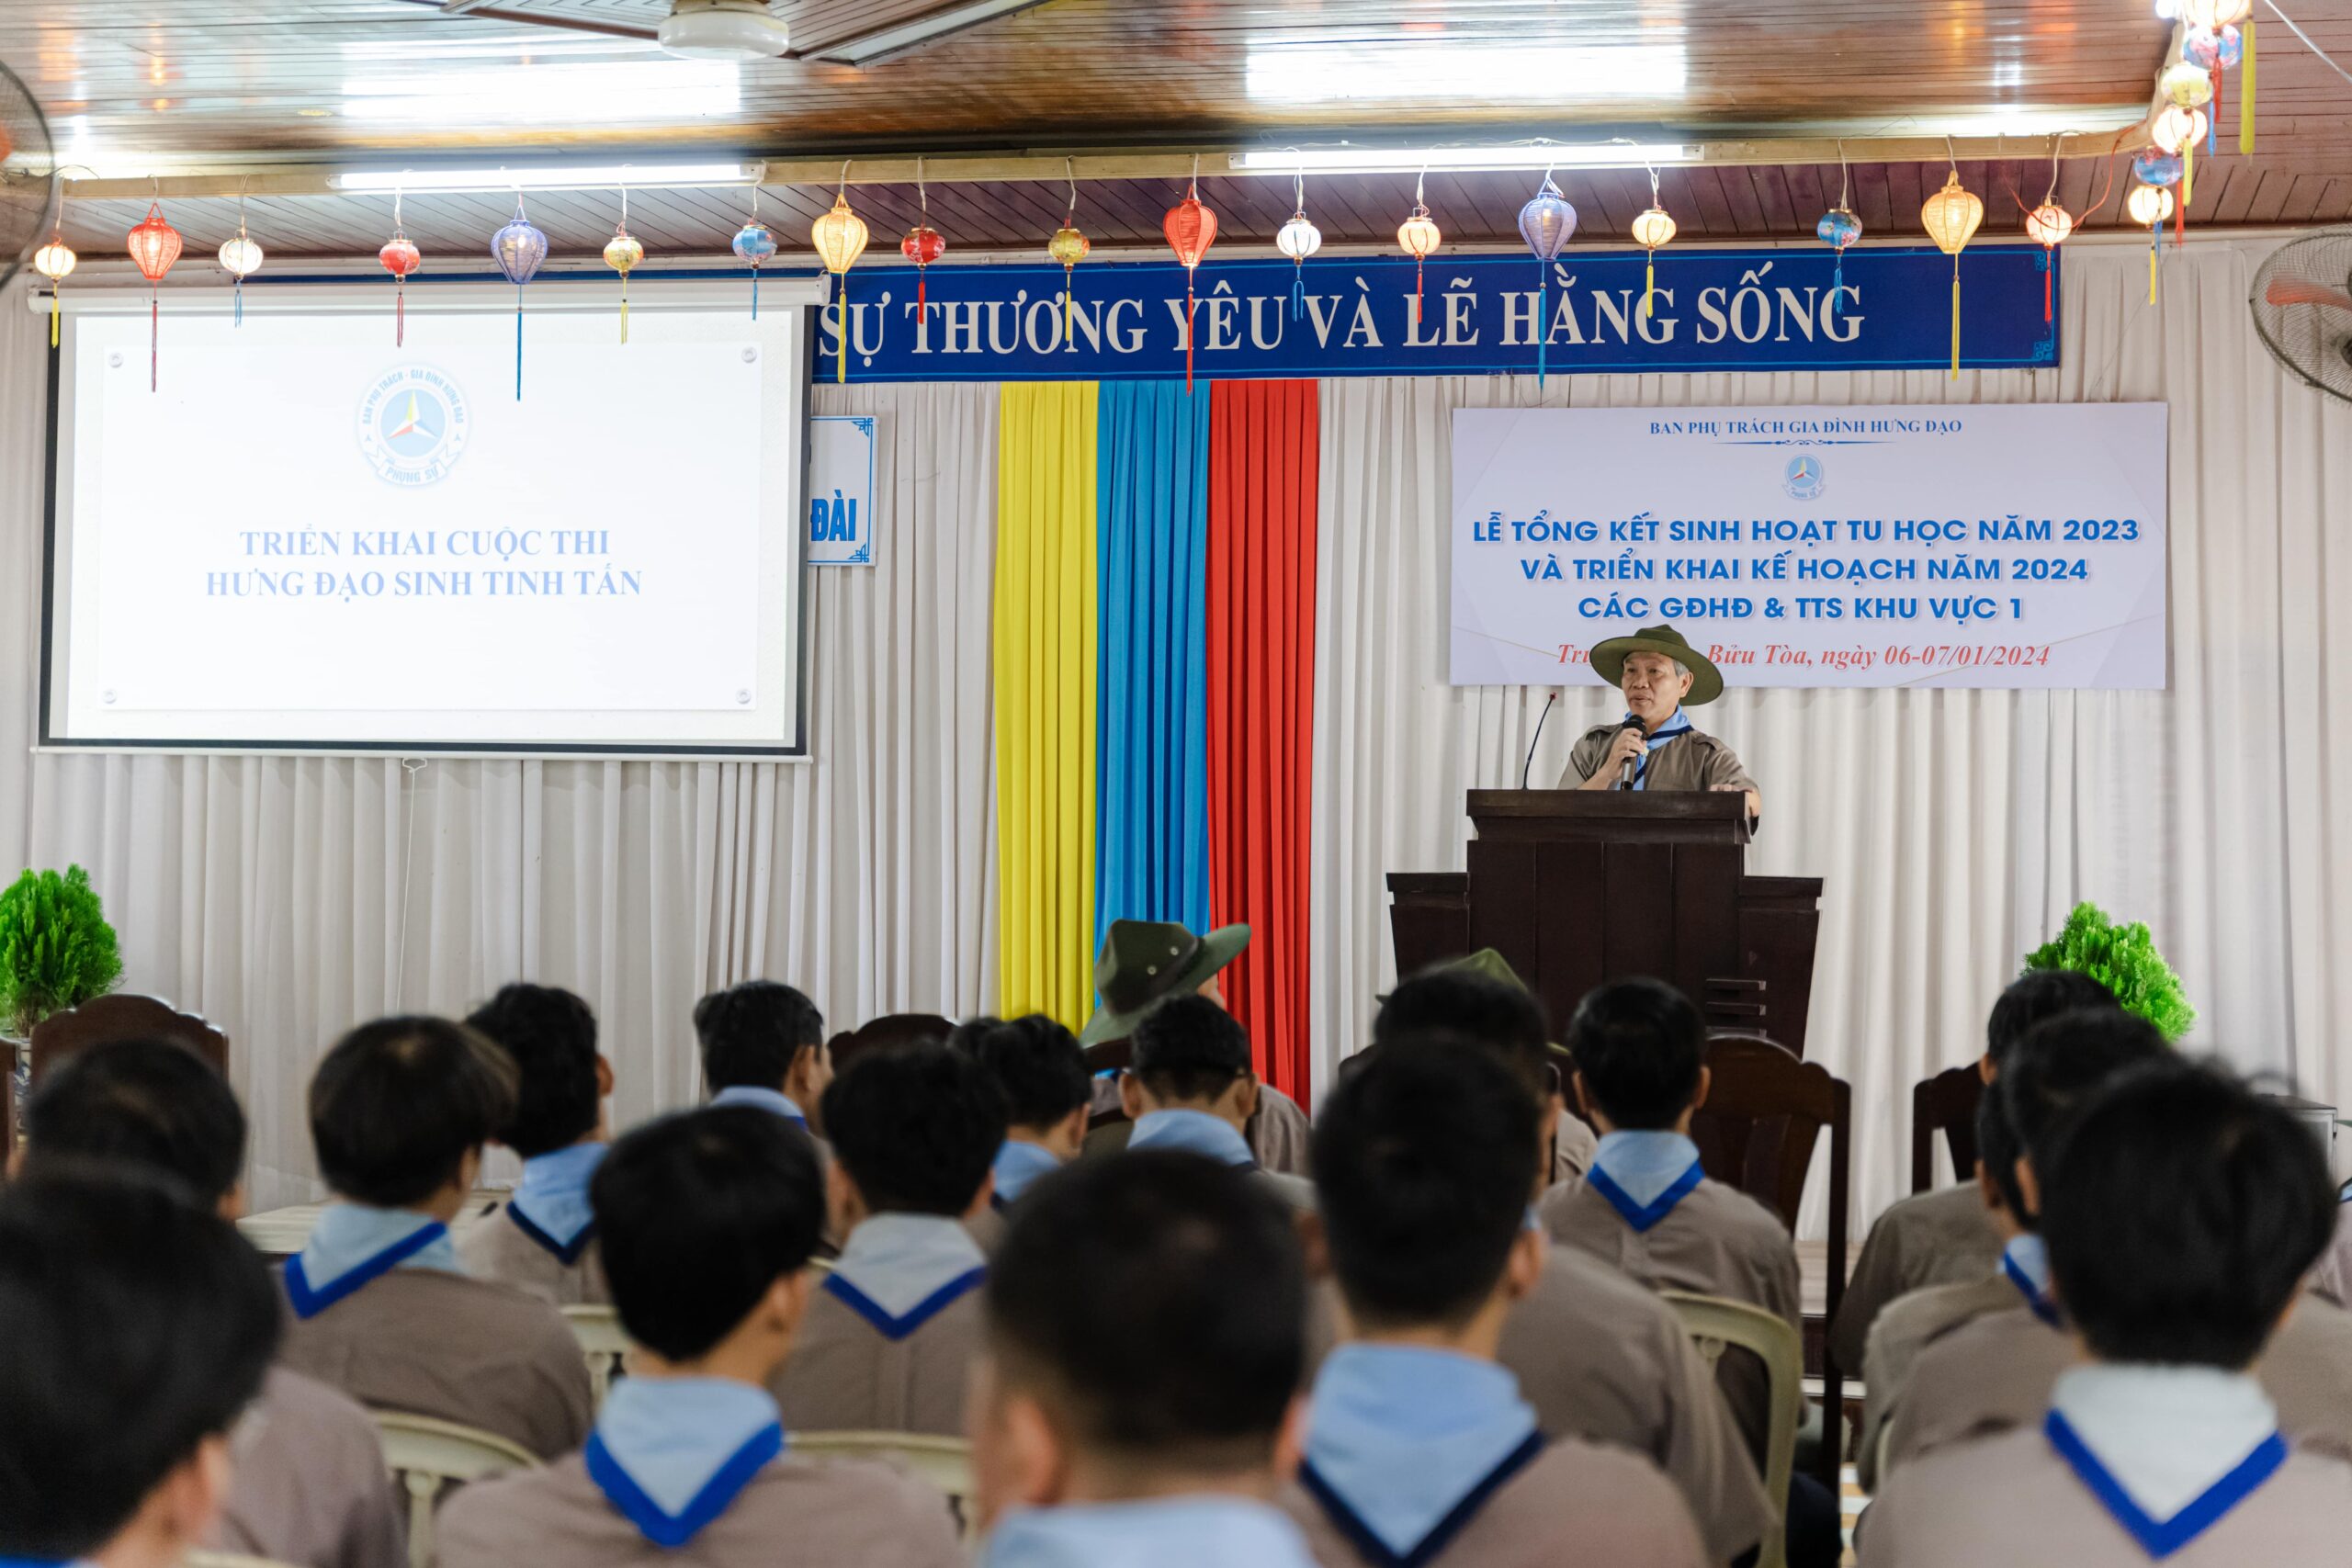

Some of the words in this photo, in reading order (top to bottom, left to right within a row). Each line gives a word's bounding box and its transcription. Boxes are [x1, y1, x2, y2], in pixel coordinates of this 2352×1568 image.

[820, 290, 891, 367] SỰ
[904, 289, 1148, 355] THƯƠNG
[1164, 279, 1287, 351] YÊU
[1302, 276, 1385, 350] VÀ
[1402, 276, 1480, 347] LẼ
[1498, 263, 1680, 345] HẰNG
[1696, 260, 1866, 343] SỐNG
[1650, 421, 1684, 434] BAN
[1689, 421, 1722, 437] PHỤ
[1725, 417, 1784, 434] TRÁCH
[1789, 420, 1819, 434] GIA
[1823, 417, 1865, 434] ĐÌNH
[1871, 418, 1920, 434] HƯNG
[1925, 420, 1962, 436] ĐẠO
[809, 489, 857, 542] ĐÀI
[1473, 511, 1503, 541] LỄ
[1510, 509, 1599, 542] TỔNG
[1610, 511, 1660, 541] KẾT
[1668, 520, 1740, 541] SINH
[1752, 519, 1838, 547] HOẠT
[1847, 519, 1883, 541] TU
[1894, 519, 1968, 547] HỌC
[1978, 513, 2052, 541] NĂM
[2063, 519, 2140, 541] 2023
[239, 523, 341, 557] TRIỂN
[352, 530, 437, 556] KHAI
[446, 526, 542, 562] CUỘC
[550, 530, 610, 555] THI
[206, 567, 304, 597] HƯNG
[313, 570, 385, 604] ĐẠO
[394, 570, 473, 596] SINH
[481, 570, 565, 596] TINH
[573, 562, 642, 596] TẤN
[1521, 552, 1563, 580] VÀ
[1572, 547, 1655, 580] TRIỂN
[1666, 558, 1739, 580] KHAI
[1751, 548, 1793, 580] KẾ
[1798, 558, 1916, 586] HOẠCH
[1928, 553, 2001, 580] NĂM
[2011, 558, 2088, 580] 2024
[1577, 591, 1650, 618] CÁC
[1659, 596, 1753, 618] GĐHĐ
[1763, 597, 1786, 618] &
[1795, 597, 1844, 619] TTS
[1854, 597, 1917, 619] KHU
[1928, 594, 1997, 626] VỰC
[2009, 598, 2021, 618] 1
[1707, 642, 1756, 664] Bửu
[1764, 643, 1813, 668] Tòa,
[1820, 644, 1877, 670] ngày
[1883, 645, 2051, 666] 06-07/01/2024
